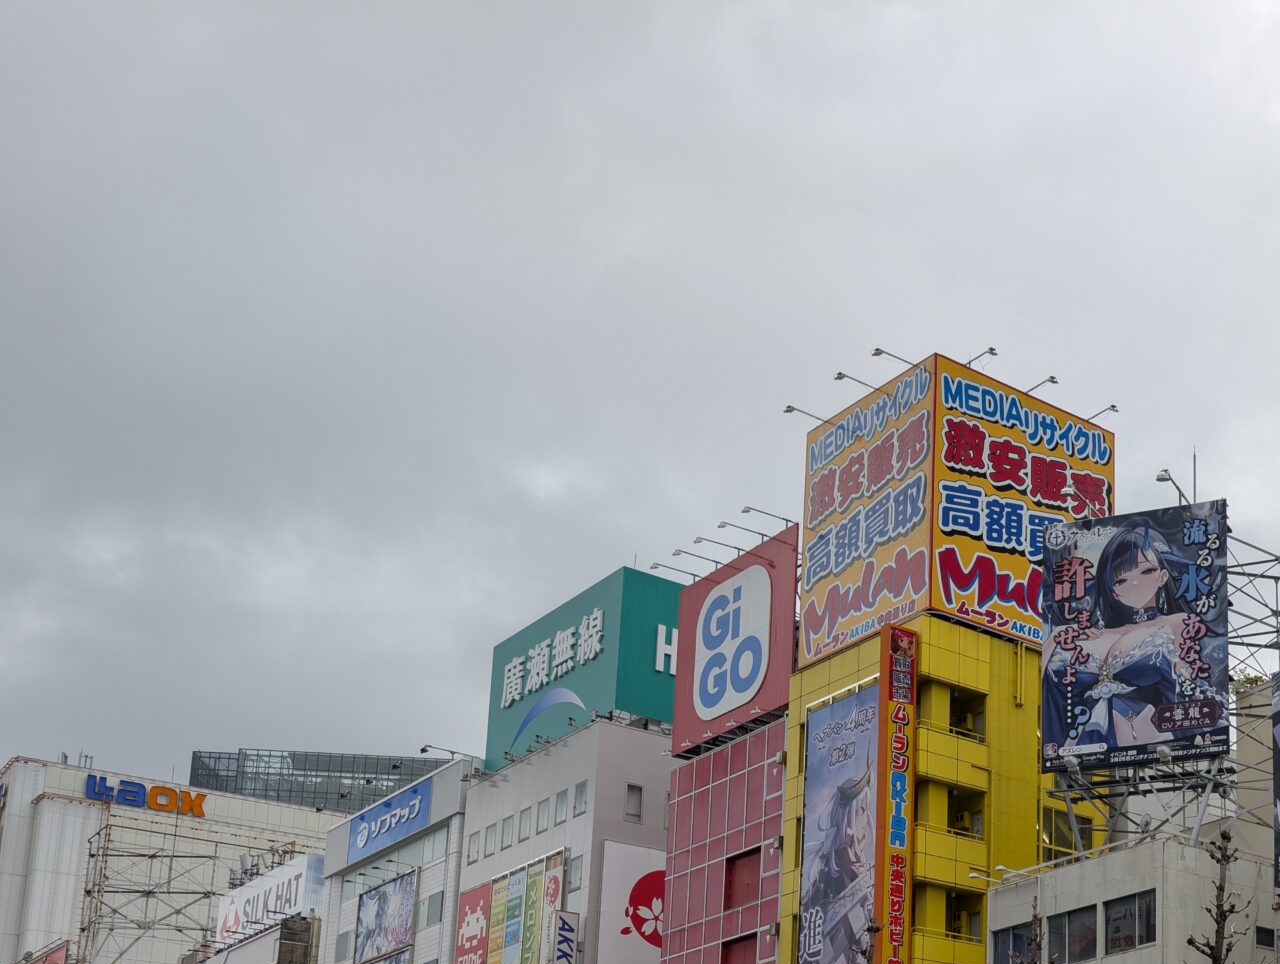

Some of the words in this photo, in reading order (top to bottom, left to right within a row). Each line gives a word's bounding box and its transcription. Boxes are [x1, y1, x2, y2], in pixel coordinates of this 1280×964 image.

[808, 364, 930, 474] MEDIAリサイクル
[941, 373, 1111, 465] MEDIAリサイクル
[808, 409, 930, 528] 激安販売
[941, 415, 1109, 518] 激安販売
[804, 471, 926, 591] 高額買取
[702, 585, 742, 651] Gi
[803, 546, 929, 657] Mulan
[955, 600, 1011, 629] ムーラン
[501, 608, 606, 710] 廣瀬無線
[699, 635, 763, 709] GO
[813, 630, 849, 657] ムーラン
[849, 617, 877, 640] AKIBA
[892, 656, 912, 671] 買取
[1172, 708, 1202, 721] 雲龍
[829, 741, 857, 768] 第2弾
[371, 796, 422, 839] ソフマップ
[243, 886, 273, 930] SILK
[274, 872, 303, 910] HAT
